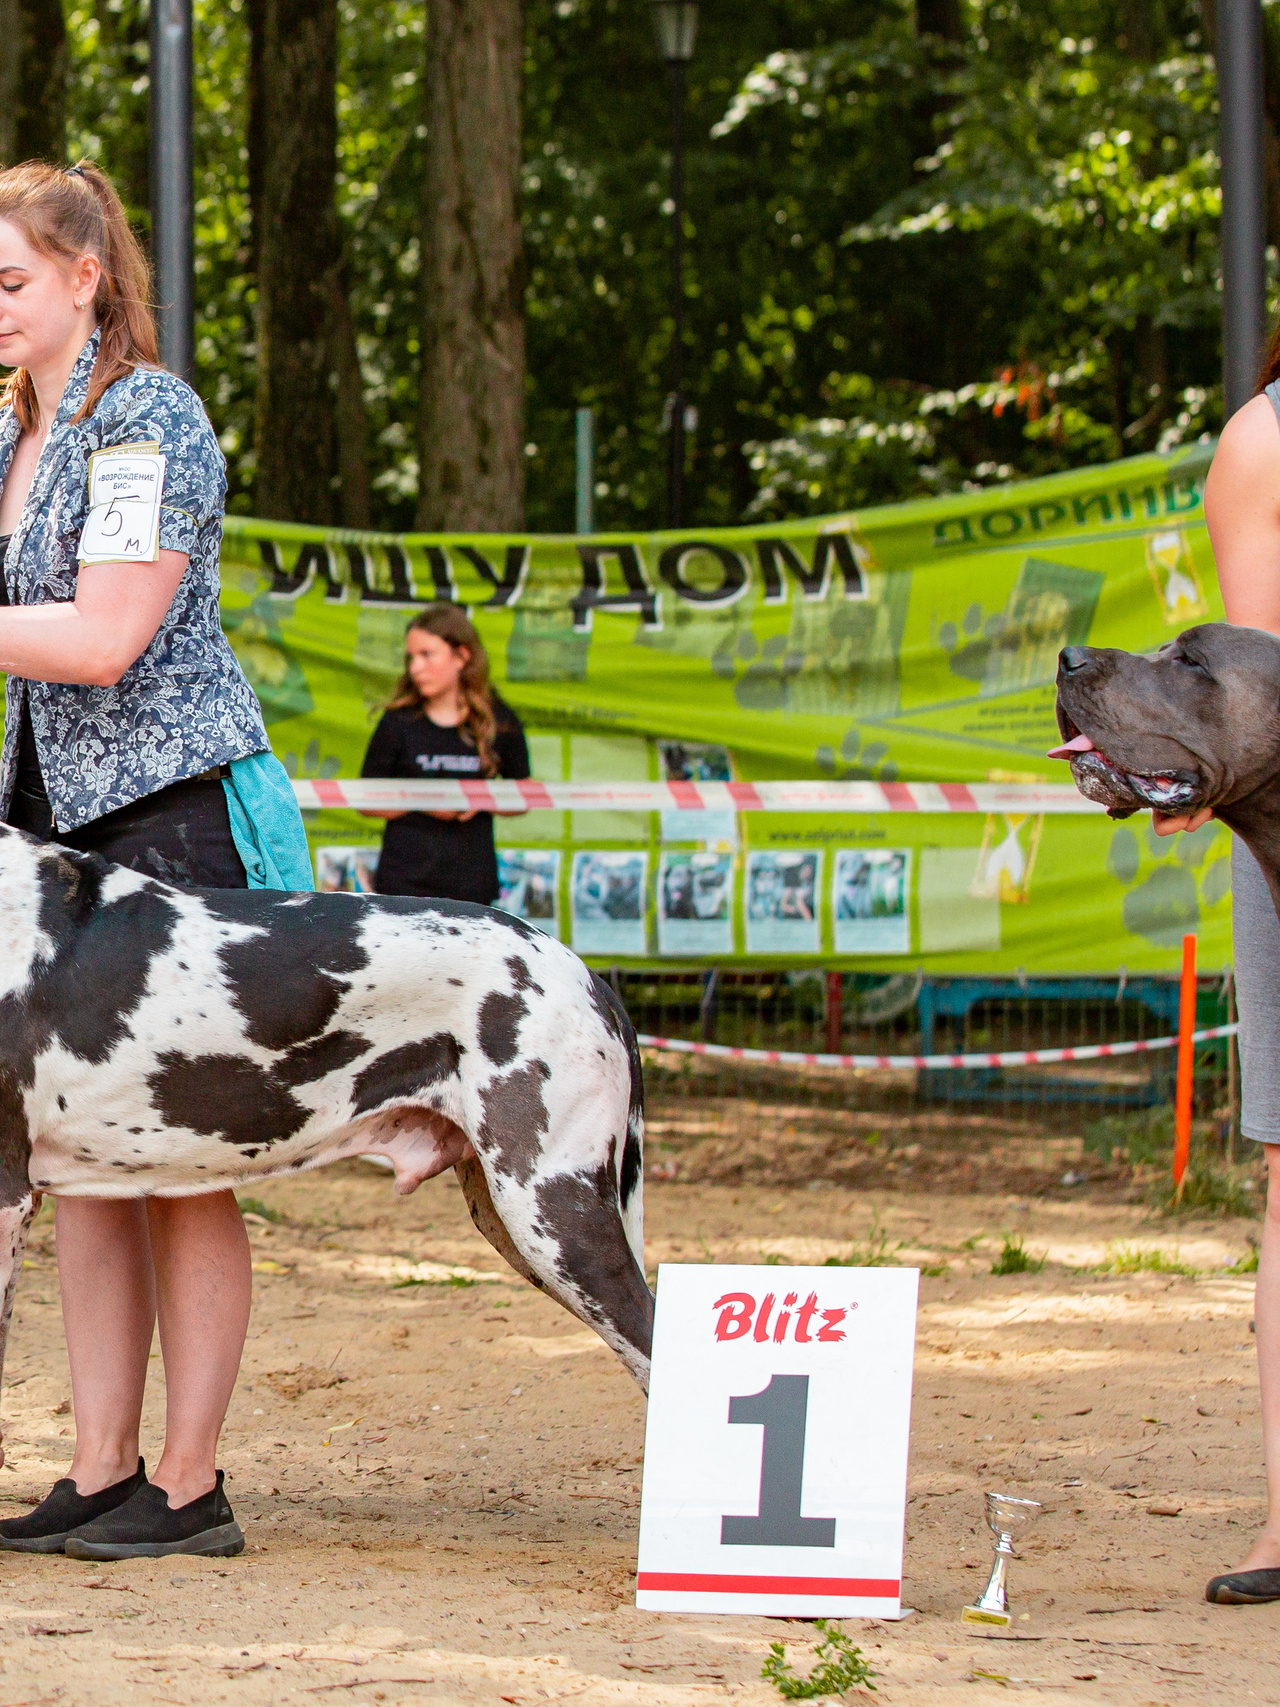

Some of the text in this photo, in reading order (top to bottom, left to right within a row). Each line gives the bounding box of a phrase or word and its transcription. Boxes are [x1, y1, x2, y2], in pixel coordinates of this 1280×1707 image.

[98, 472, 155, 482] «ВОЗРОЖДЕНИЕ
[112, 482, 132, 490] БИС»
[101, 494, 141, 537] 5
[258, 535, 869, 632] ИЩУ ДОМ
[711, 1289, 848, 1345] Blitz
[719, 1373, 837, 1548] 1
